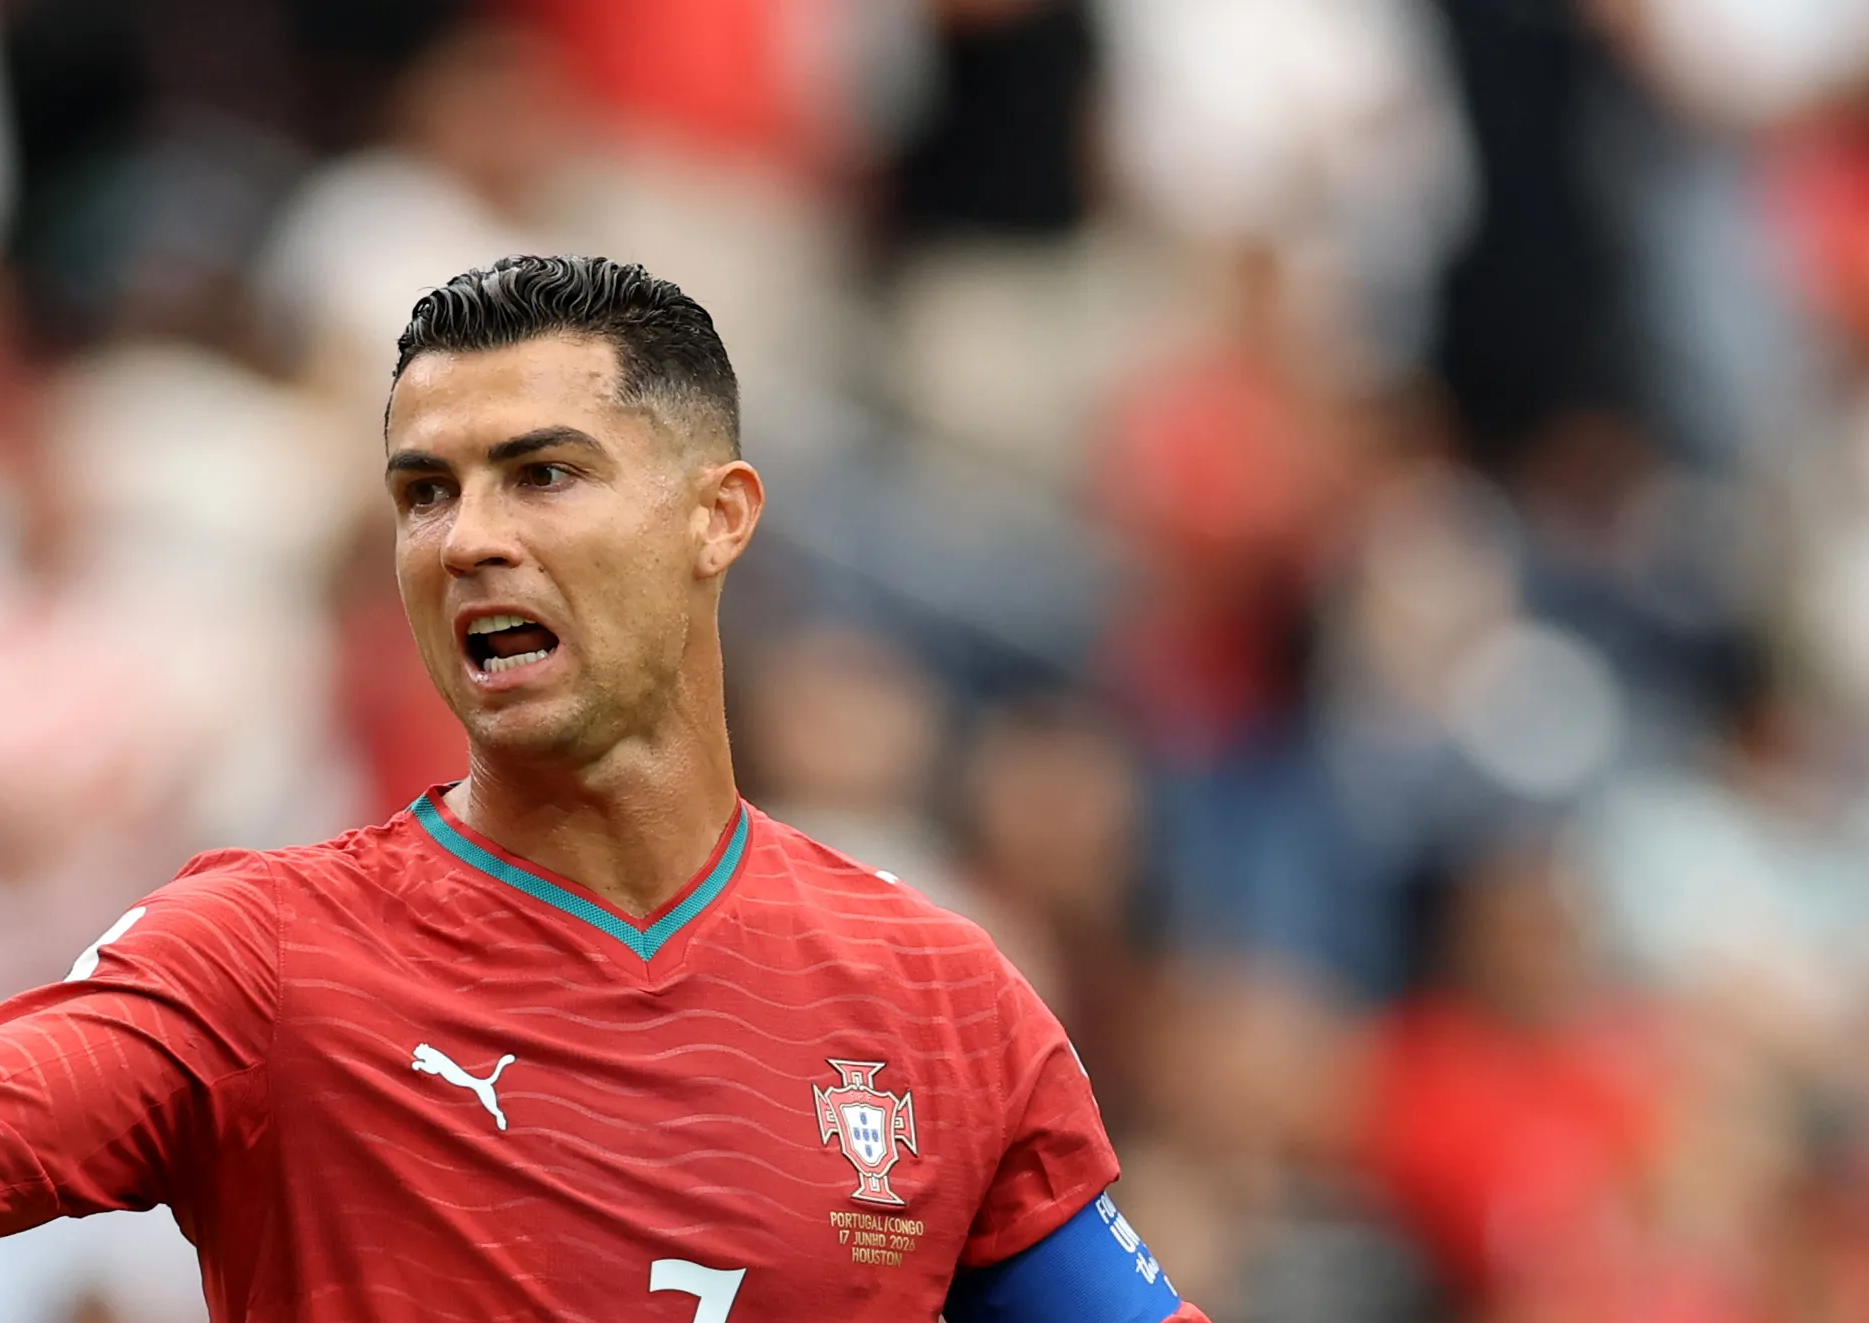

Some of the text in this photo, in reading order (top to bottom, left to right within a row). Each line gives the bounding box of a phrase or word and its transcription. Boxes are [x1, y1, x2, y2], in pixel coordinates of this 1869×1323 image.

[829, 1211, 924, 1236] PORTUGAL/CONGO
[839, 1229, 916, 1251] 17 JUNHO 2026
[851, 1247, 904, 1267] HOUSTON
